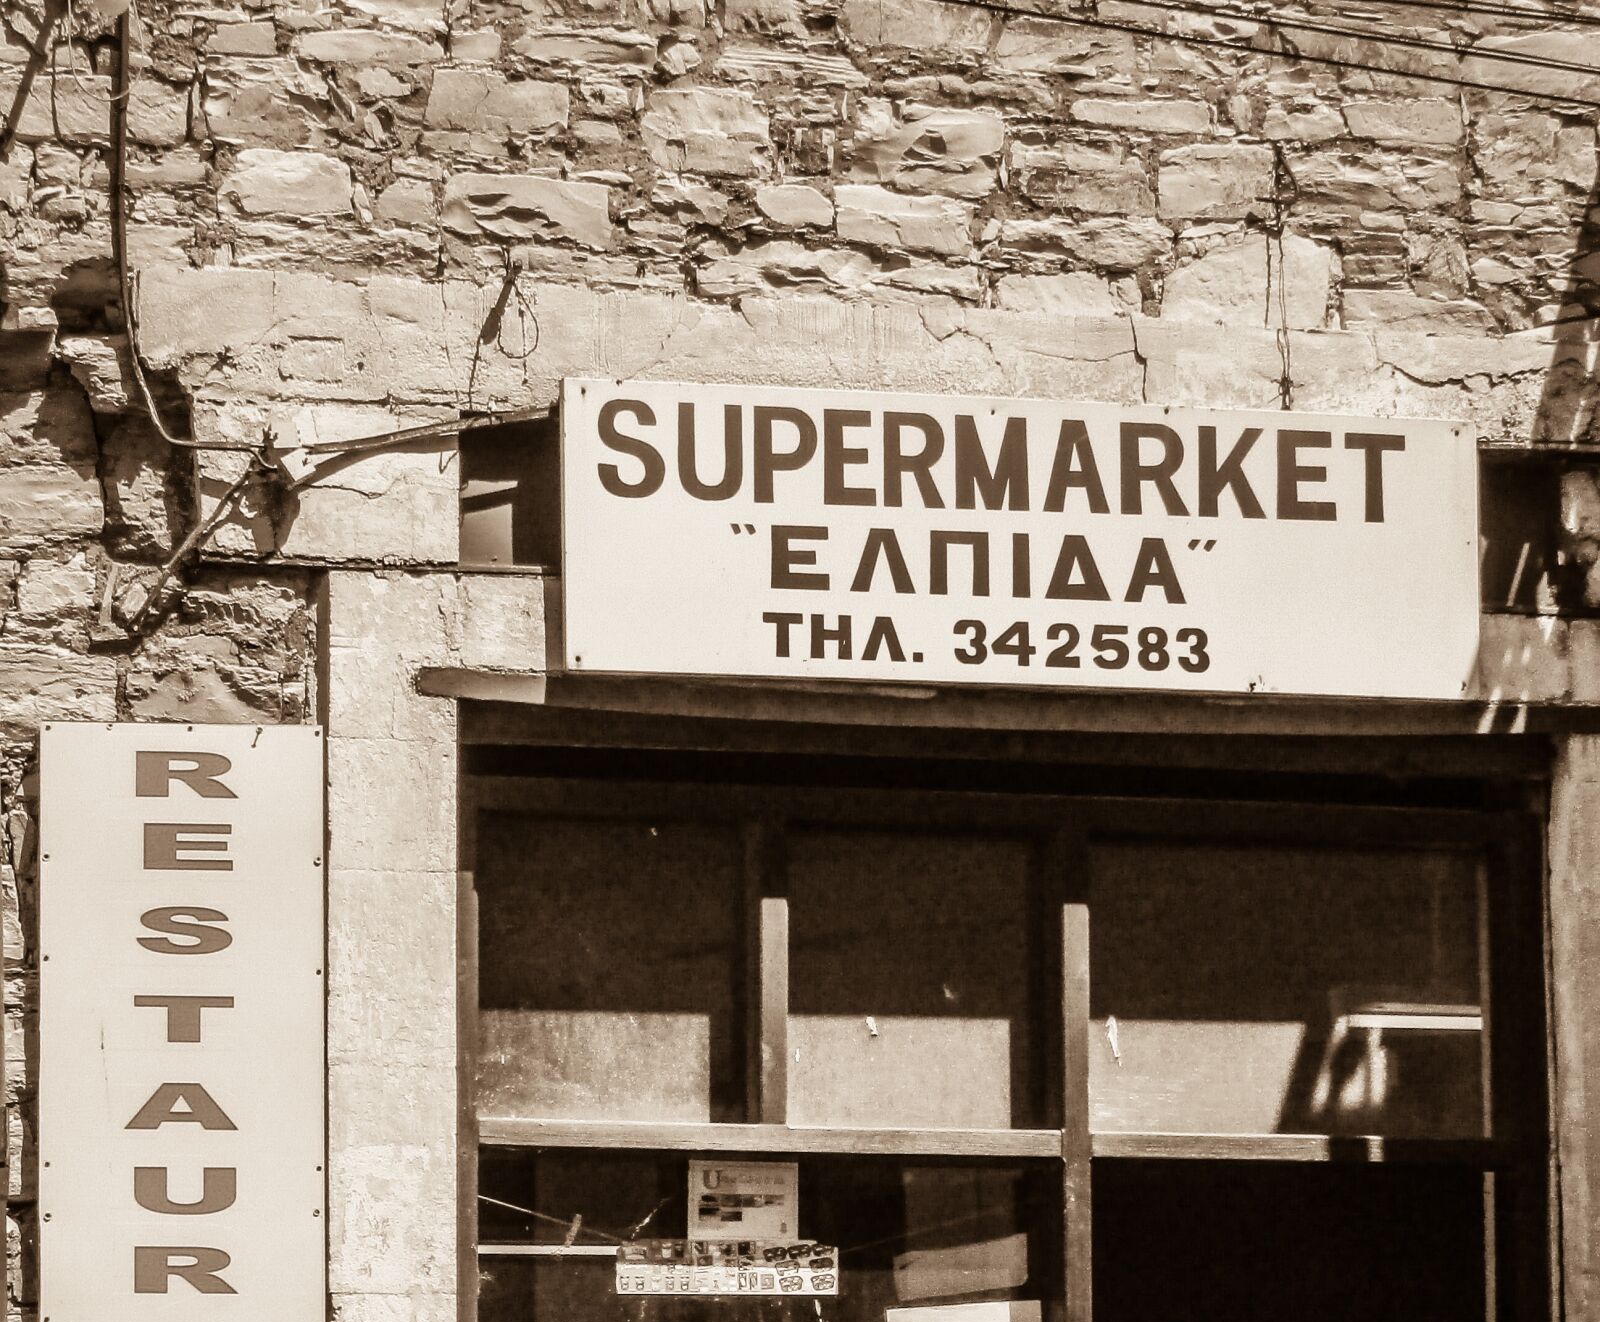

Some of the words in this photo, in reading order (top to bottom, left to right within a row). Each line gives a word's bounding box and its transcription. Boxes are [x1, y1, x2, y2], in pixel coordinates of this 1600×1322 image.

[597, 398, 1406, 524] SUPERMARKET
[762, 612, 924, 663] ΤΗΛ.
[952, 618, 1211, 674] 342583
